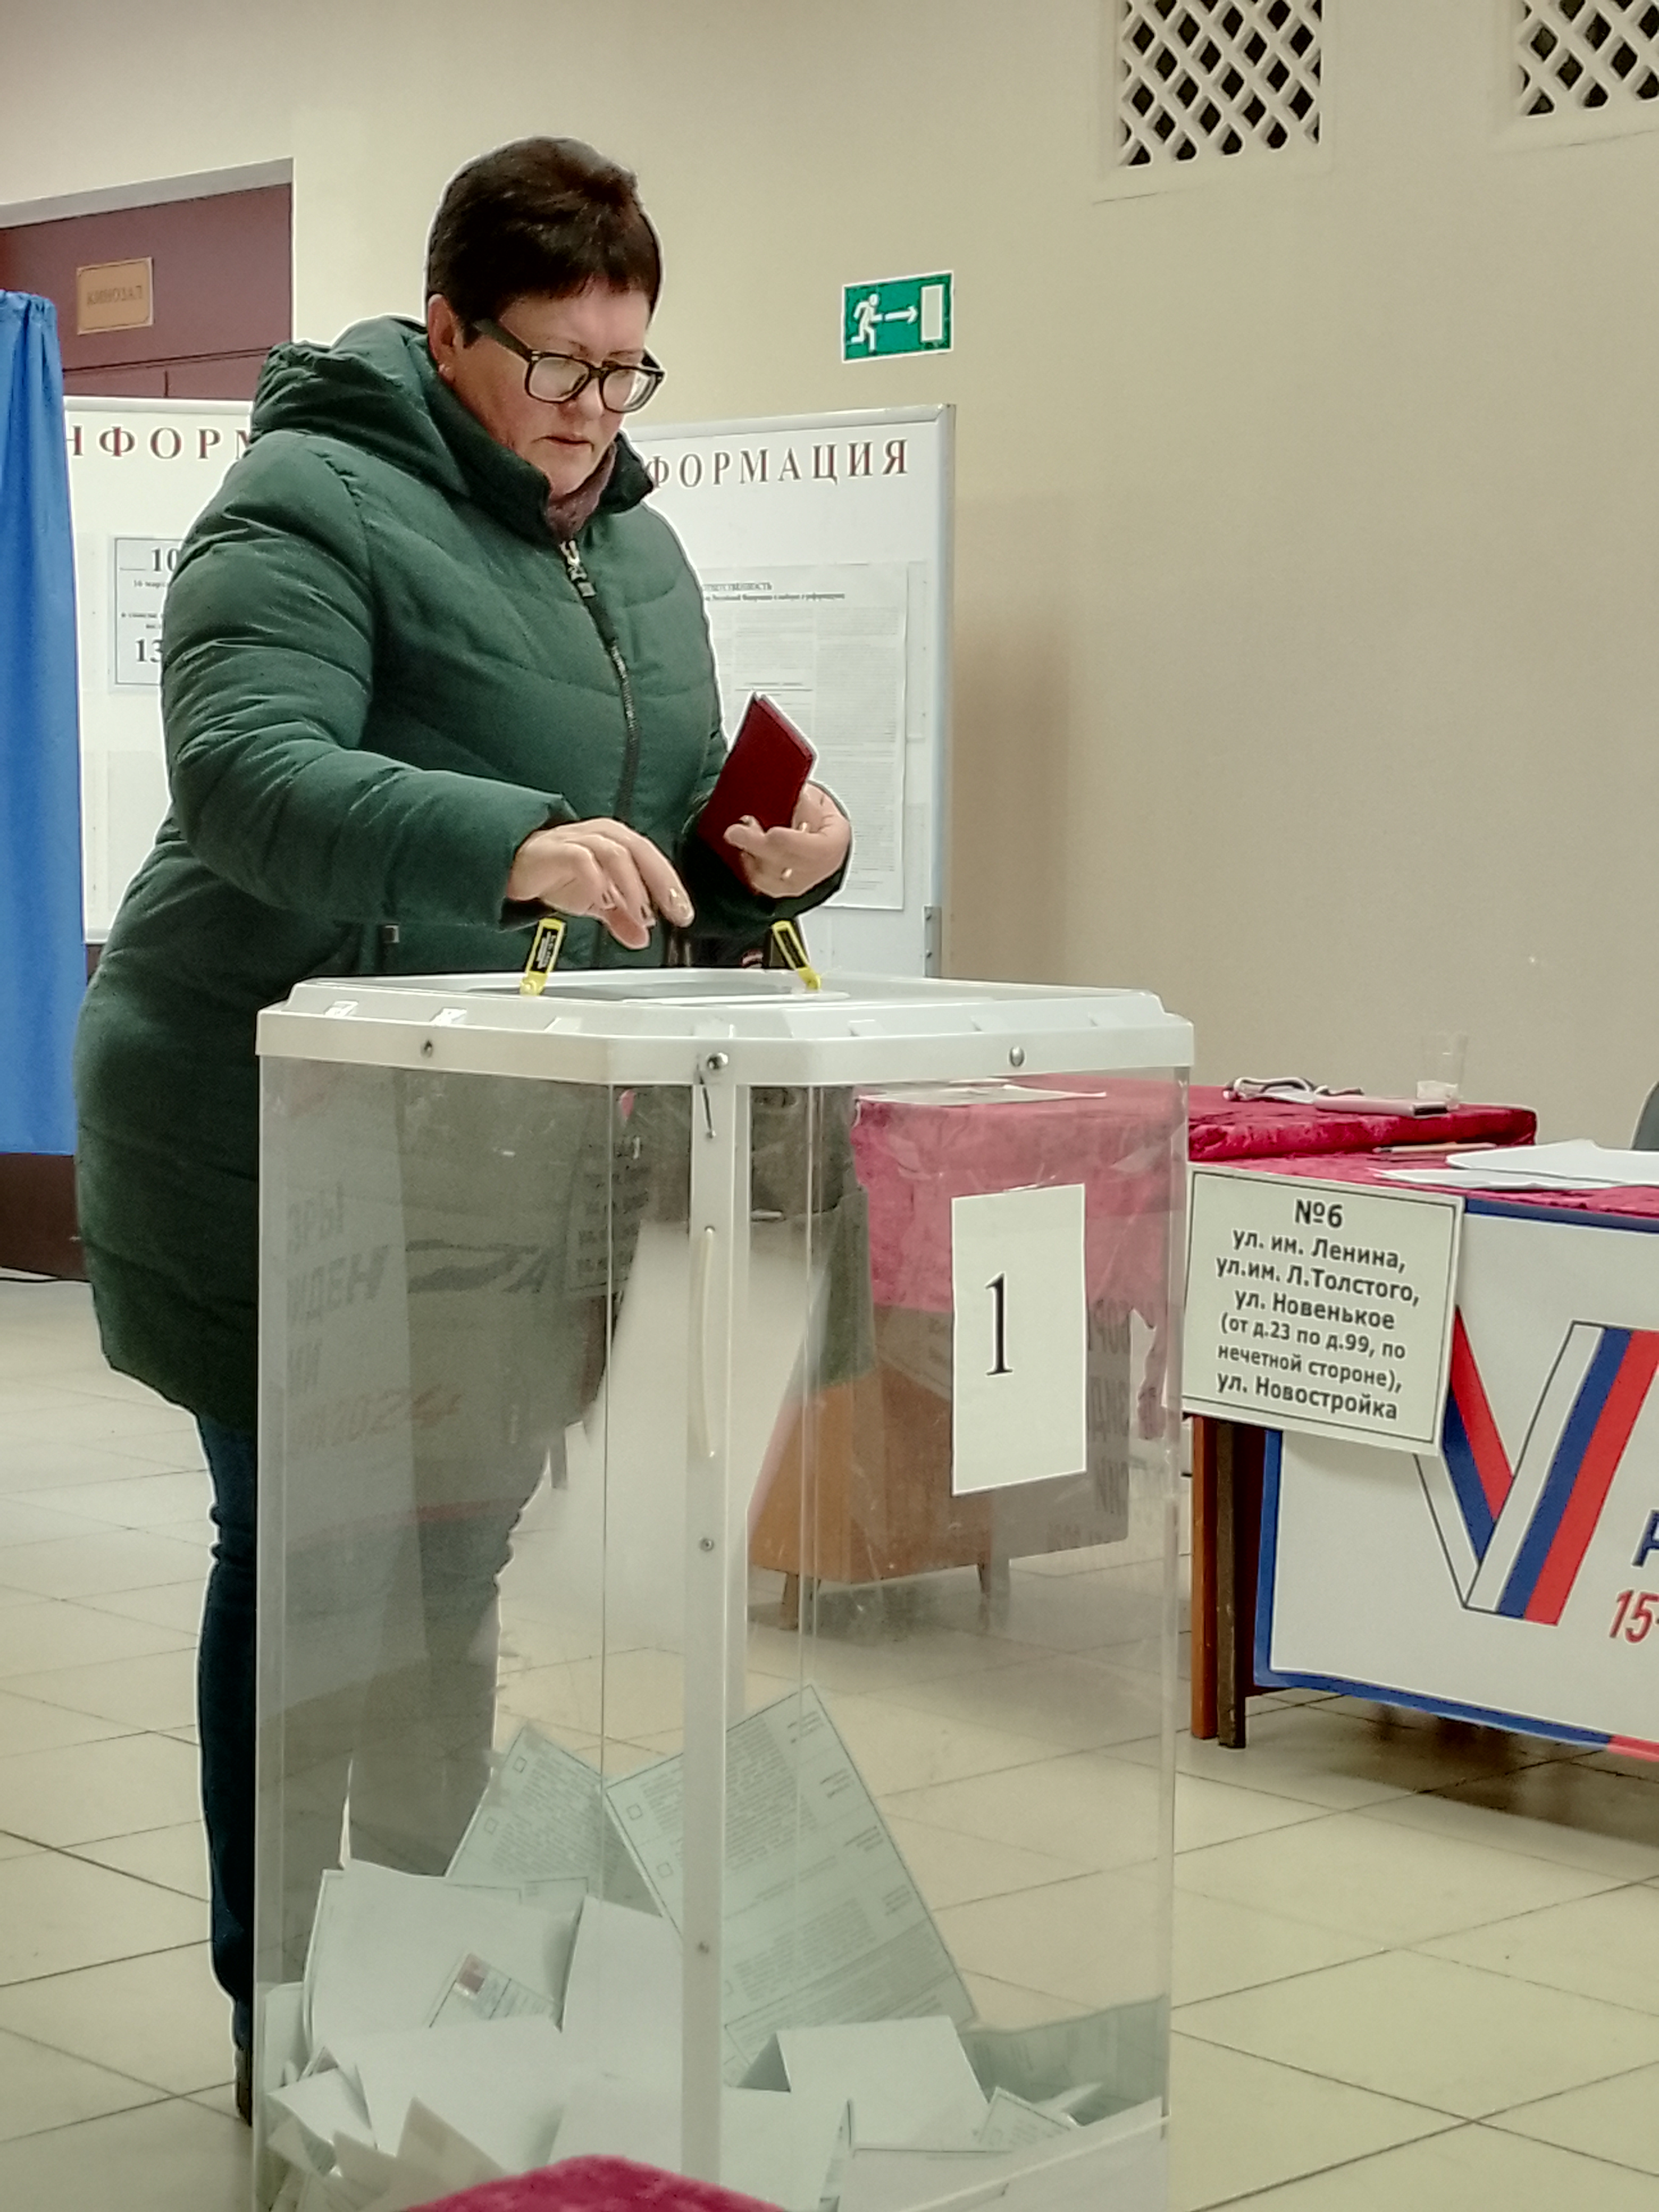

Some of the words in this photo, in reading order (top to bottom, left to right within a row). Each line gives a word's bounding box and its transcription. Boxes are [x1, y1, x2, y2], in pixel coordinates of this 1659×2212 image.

[647, 438, 908, 488] ФОРМАЦИЯ
[1295, 1200, 1342, 1228] №6
[1234, 1230, 1263, 1250] ул.
[1271, 1237, 1303, 1254] им.
[1312, 1238, 1405, 1273] Ленина,
[1217, 1258, 1280, 1281] ул.им.
[1287, 1266, 1419, 1306] Л.Толстого,
[985, 1272, 1013, 1376] 1
[1236, 1291, 1265, 1310] ул.
[1273, 1293, 1394, 1329] Новенькое
[1222, 1312, 1248, 1334] (от
[1253, 1321, 1289, 1340] д.23
[1297, 1330, 1320, 1345] по
[1326, 1334, 1375, 1357] д.99,
[1382, 1344, 1405, 1359] по
[1218, 1346, 1302, 1372] нечетной
[1309, 1362, 1401, 1393] стороне),
[1218, 1373, 1247, 1393] ул.
[1256, 1376, 1397, 1419] Новостройка
